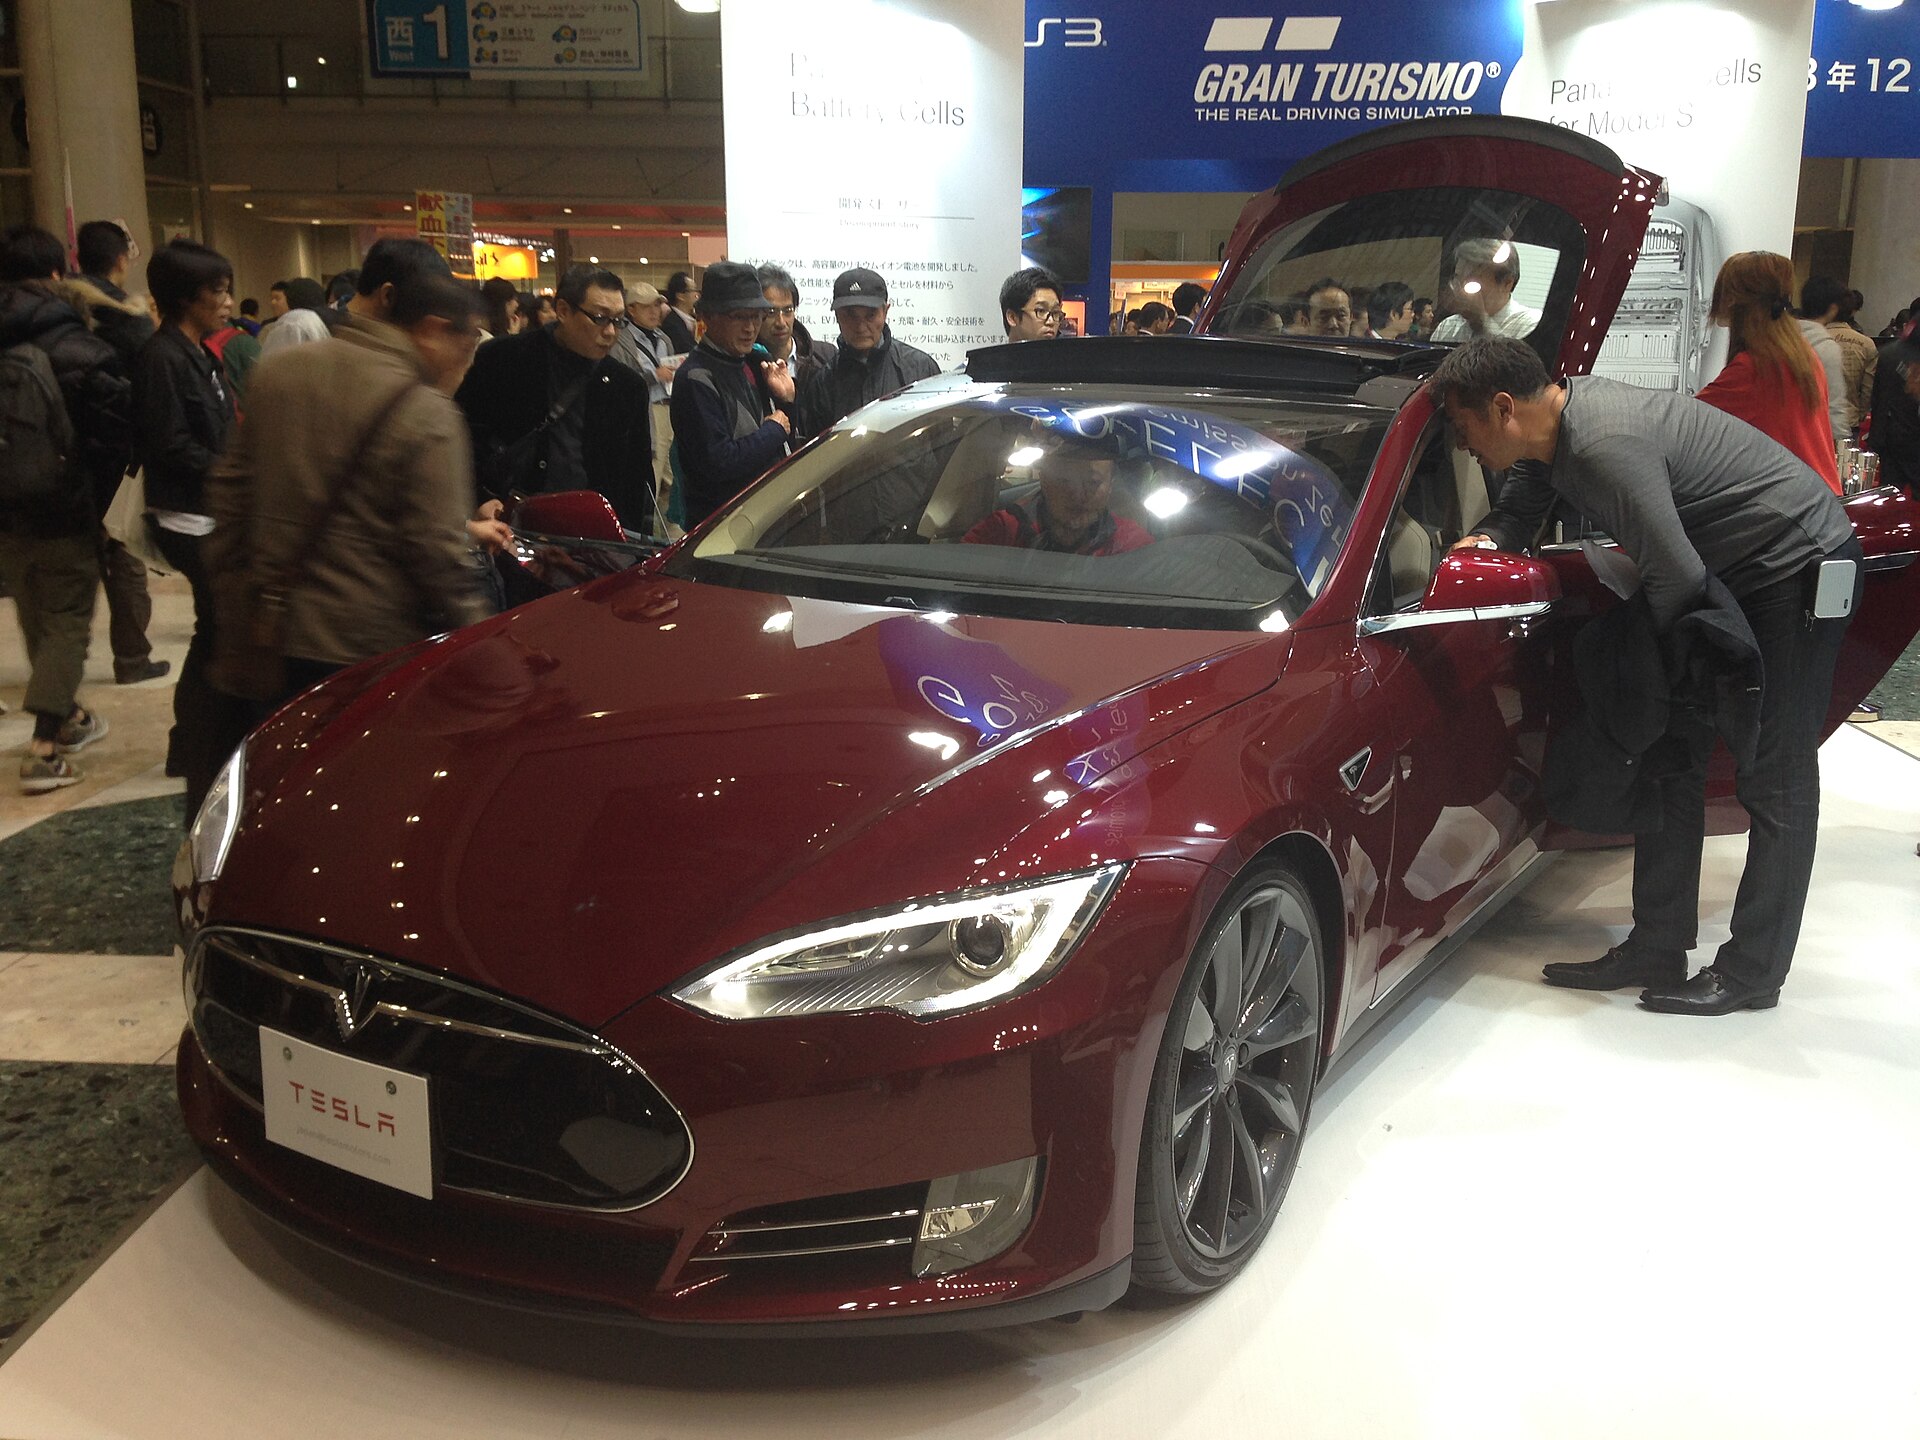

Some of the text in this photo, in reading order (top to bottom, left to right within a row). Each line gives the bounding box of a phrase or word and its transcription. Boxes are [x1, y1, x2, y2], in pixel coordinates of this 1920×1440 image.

[385, 16, 413, 47] 西
[423, 5, 449, 60] 1
[1194, 63, 1303, 103] GRAN
[899, 99, 965, 127] Cells
[1195, 108, 1229, 121] THE
[1236, 108, 1282, 121] REAL
[1287, 108, 1361, 121] DRIVING
[289, 1080, 396, 1138] TESLA
